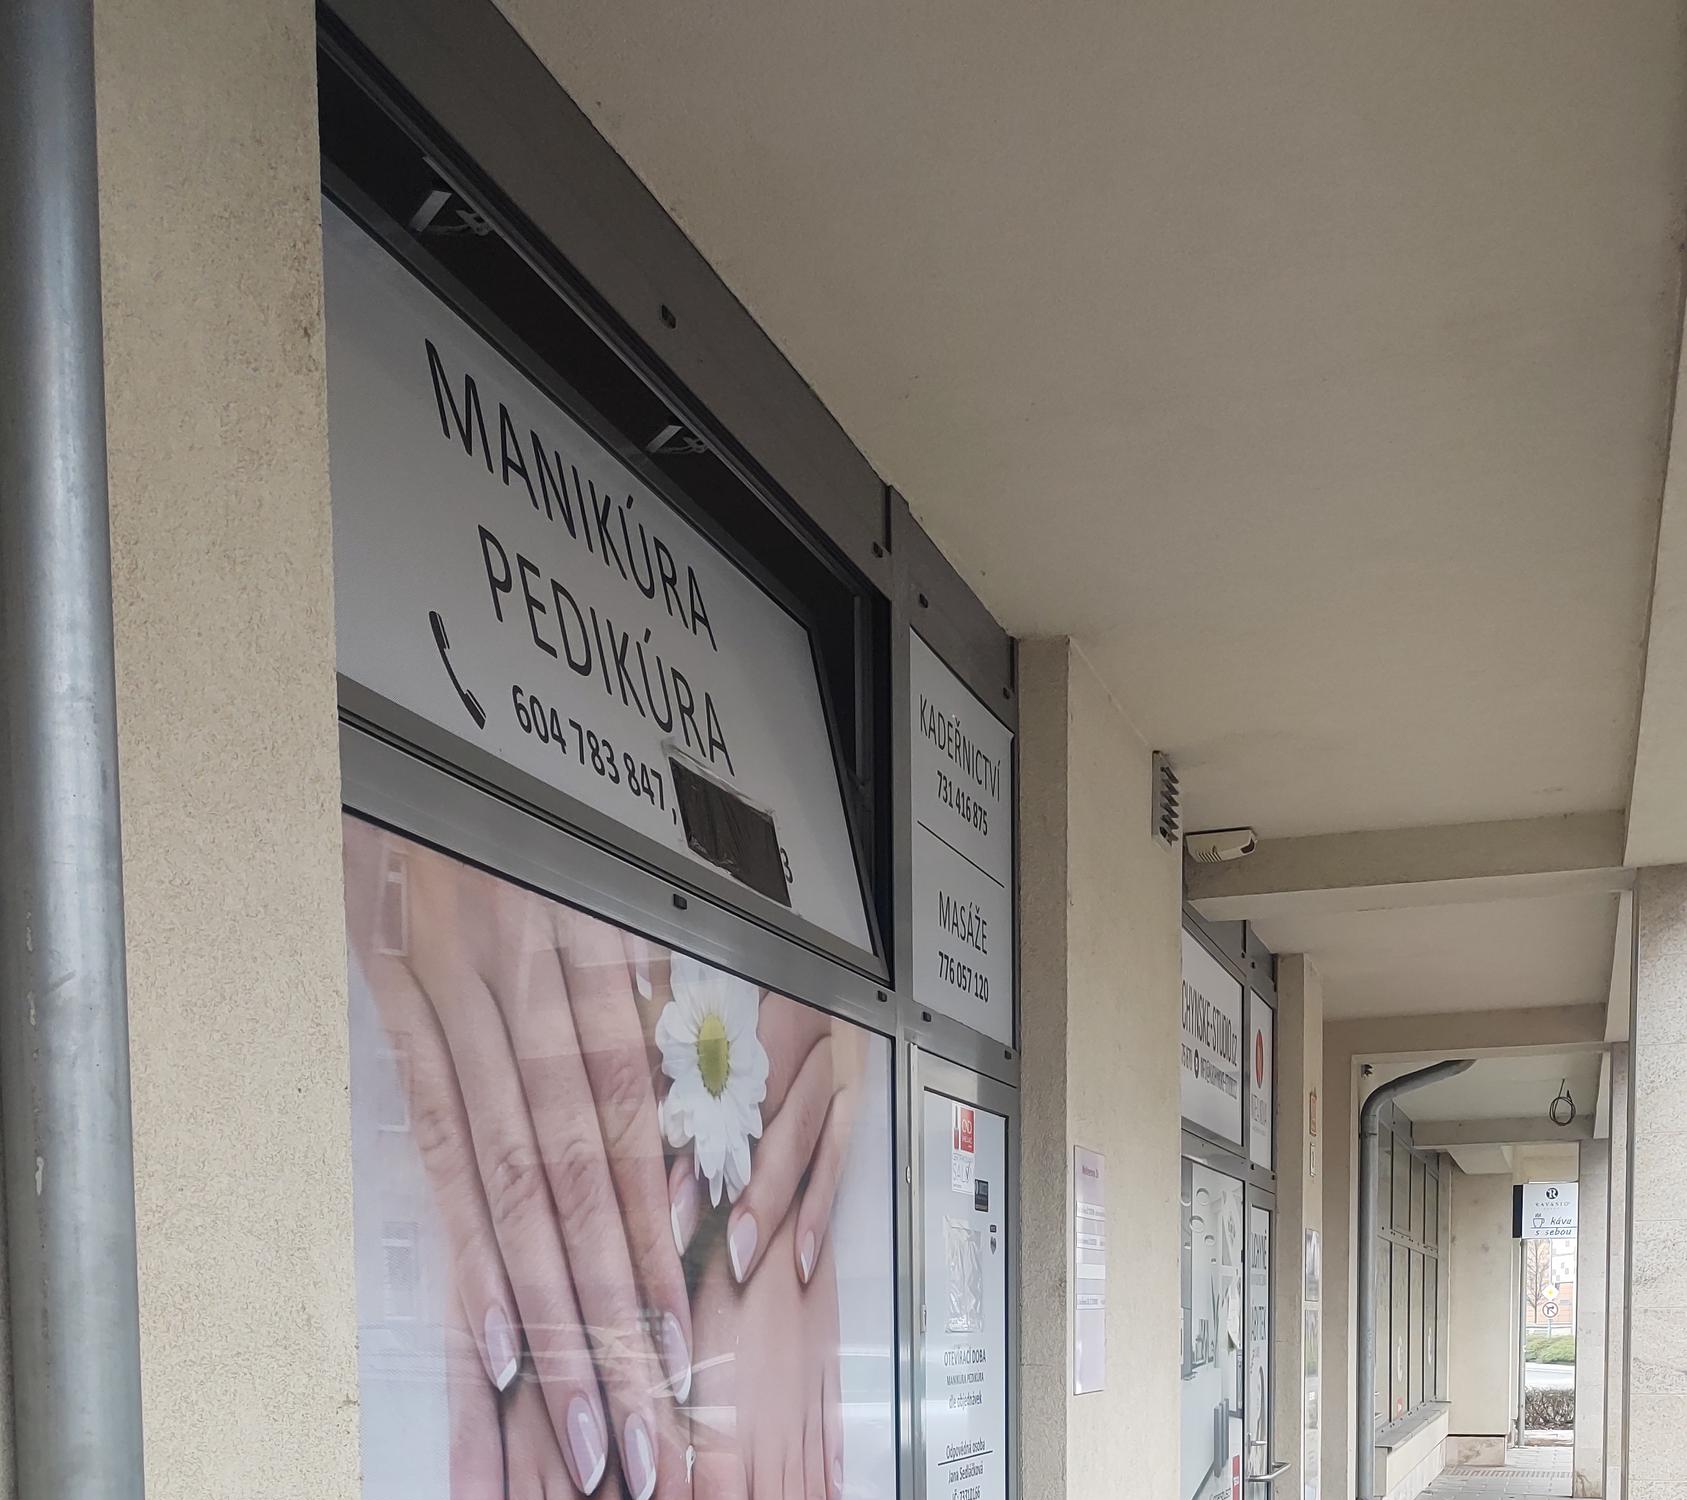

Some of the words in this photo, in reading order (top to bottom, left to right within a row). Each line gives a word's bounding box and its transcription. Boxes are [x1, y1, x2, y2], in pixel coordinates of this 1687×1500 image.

[425, 337, 718, 652] MANIKÚRA
[478, 523, 735, 776] PEDIKÚRA
[511, 683, 568, 753] 604
[568, 719, 620, 785] 783
[919, 693, 1001, 803] KADEŘNICTVÍ
[936, 769, 955, 808] 731
[955, 788, 972, 823] 416
[972, 801, 989, 836] 875
[938, 889, 988, 955] MASÁŽE
[938, 950, 956, 981] 776
[956, 962, 972, 992] 057
[973, 974, 989, 1003] 120
[1544, 1227, 1572, 1236] sebou
[1551, 1216, 1572, 1226] káva
[972, 1349, 986, 1363] DOBA
[972, 1438, 985, 1451] osoba
[948, 1470, 959, 1484] Jana
